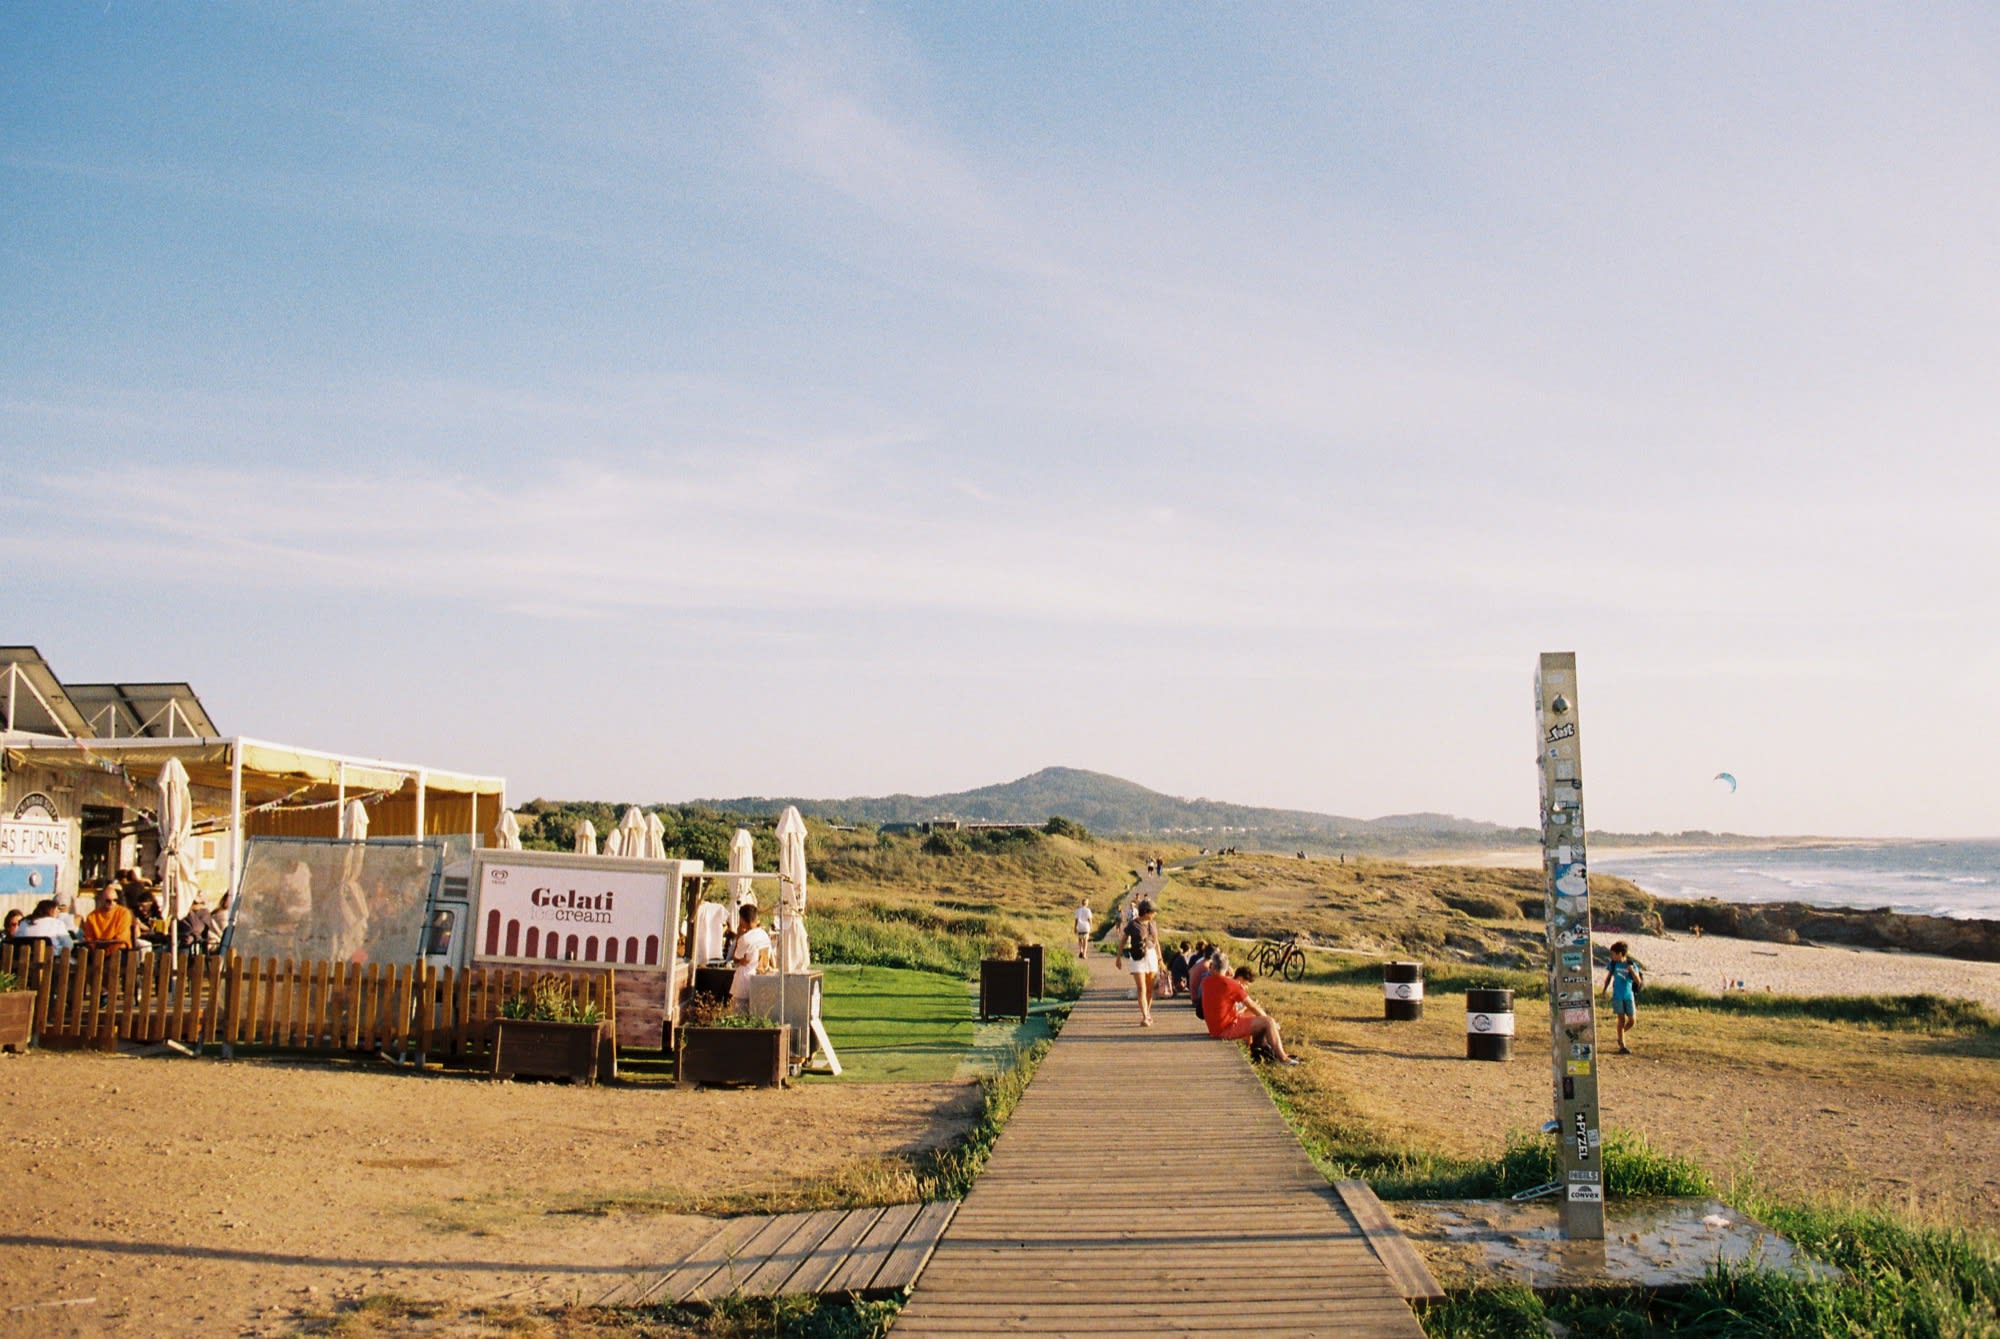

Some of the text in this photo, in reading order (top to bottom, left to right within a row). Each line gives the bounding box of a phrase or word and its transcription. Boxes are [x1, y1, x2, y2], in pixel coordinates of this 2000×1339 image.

[1, 828, 67, 855] AS FURNAS
[531, 887, 614, 910] Gelati
[1576, 1122, 1588, 1160] PYZEL
